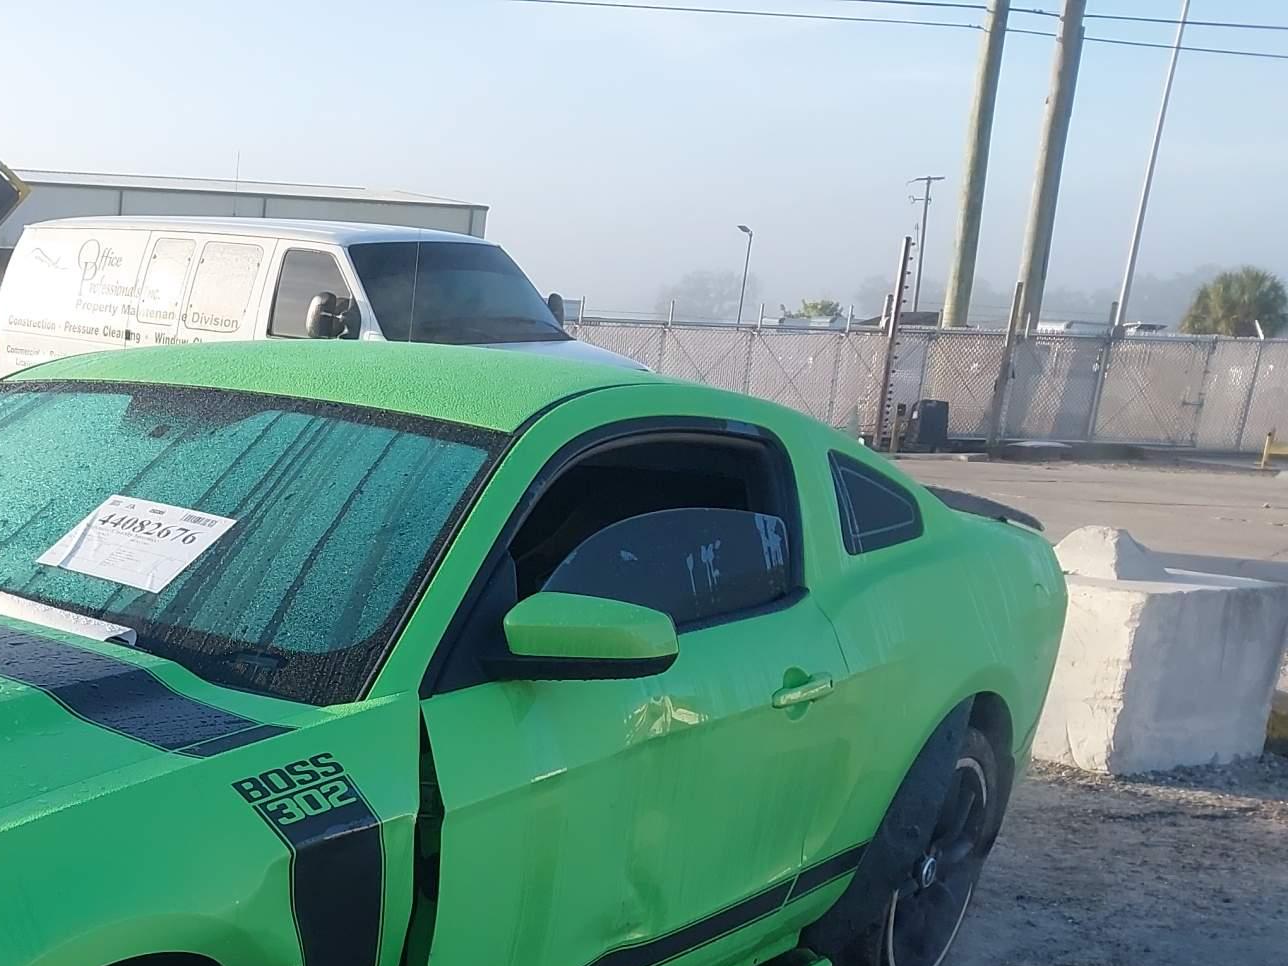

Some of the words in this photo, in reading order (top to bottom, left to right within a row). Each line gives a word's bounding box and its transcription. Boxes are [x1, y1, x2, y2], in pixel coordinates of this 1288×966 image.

[78, 239, 123, 271] Office
[8, 315, 56, 331] Construction
[64, 321, 100, 337] Pressure
[102, 326, 141, 344] Cleanng
[75, 299, 118, 318] Property
[121, 303, 188, 323] Matenane
[191, 311, 240, 329] Division
[98, 512, 207, 545] 44082676
[231, 752, 345, 804] BOSS
[267, 780, 357, 826] 302
